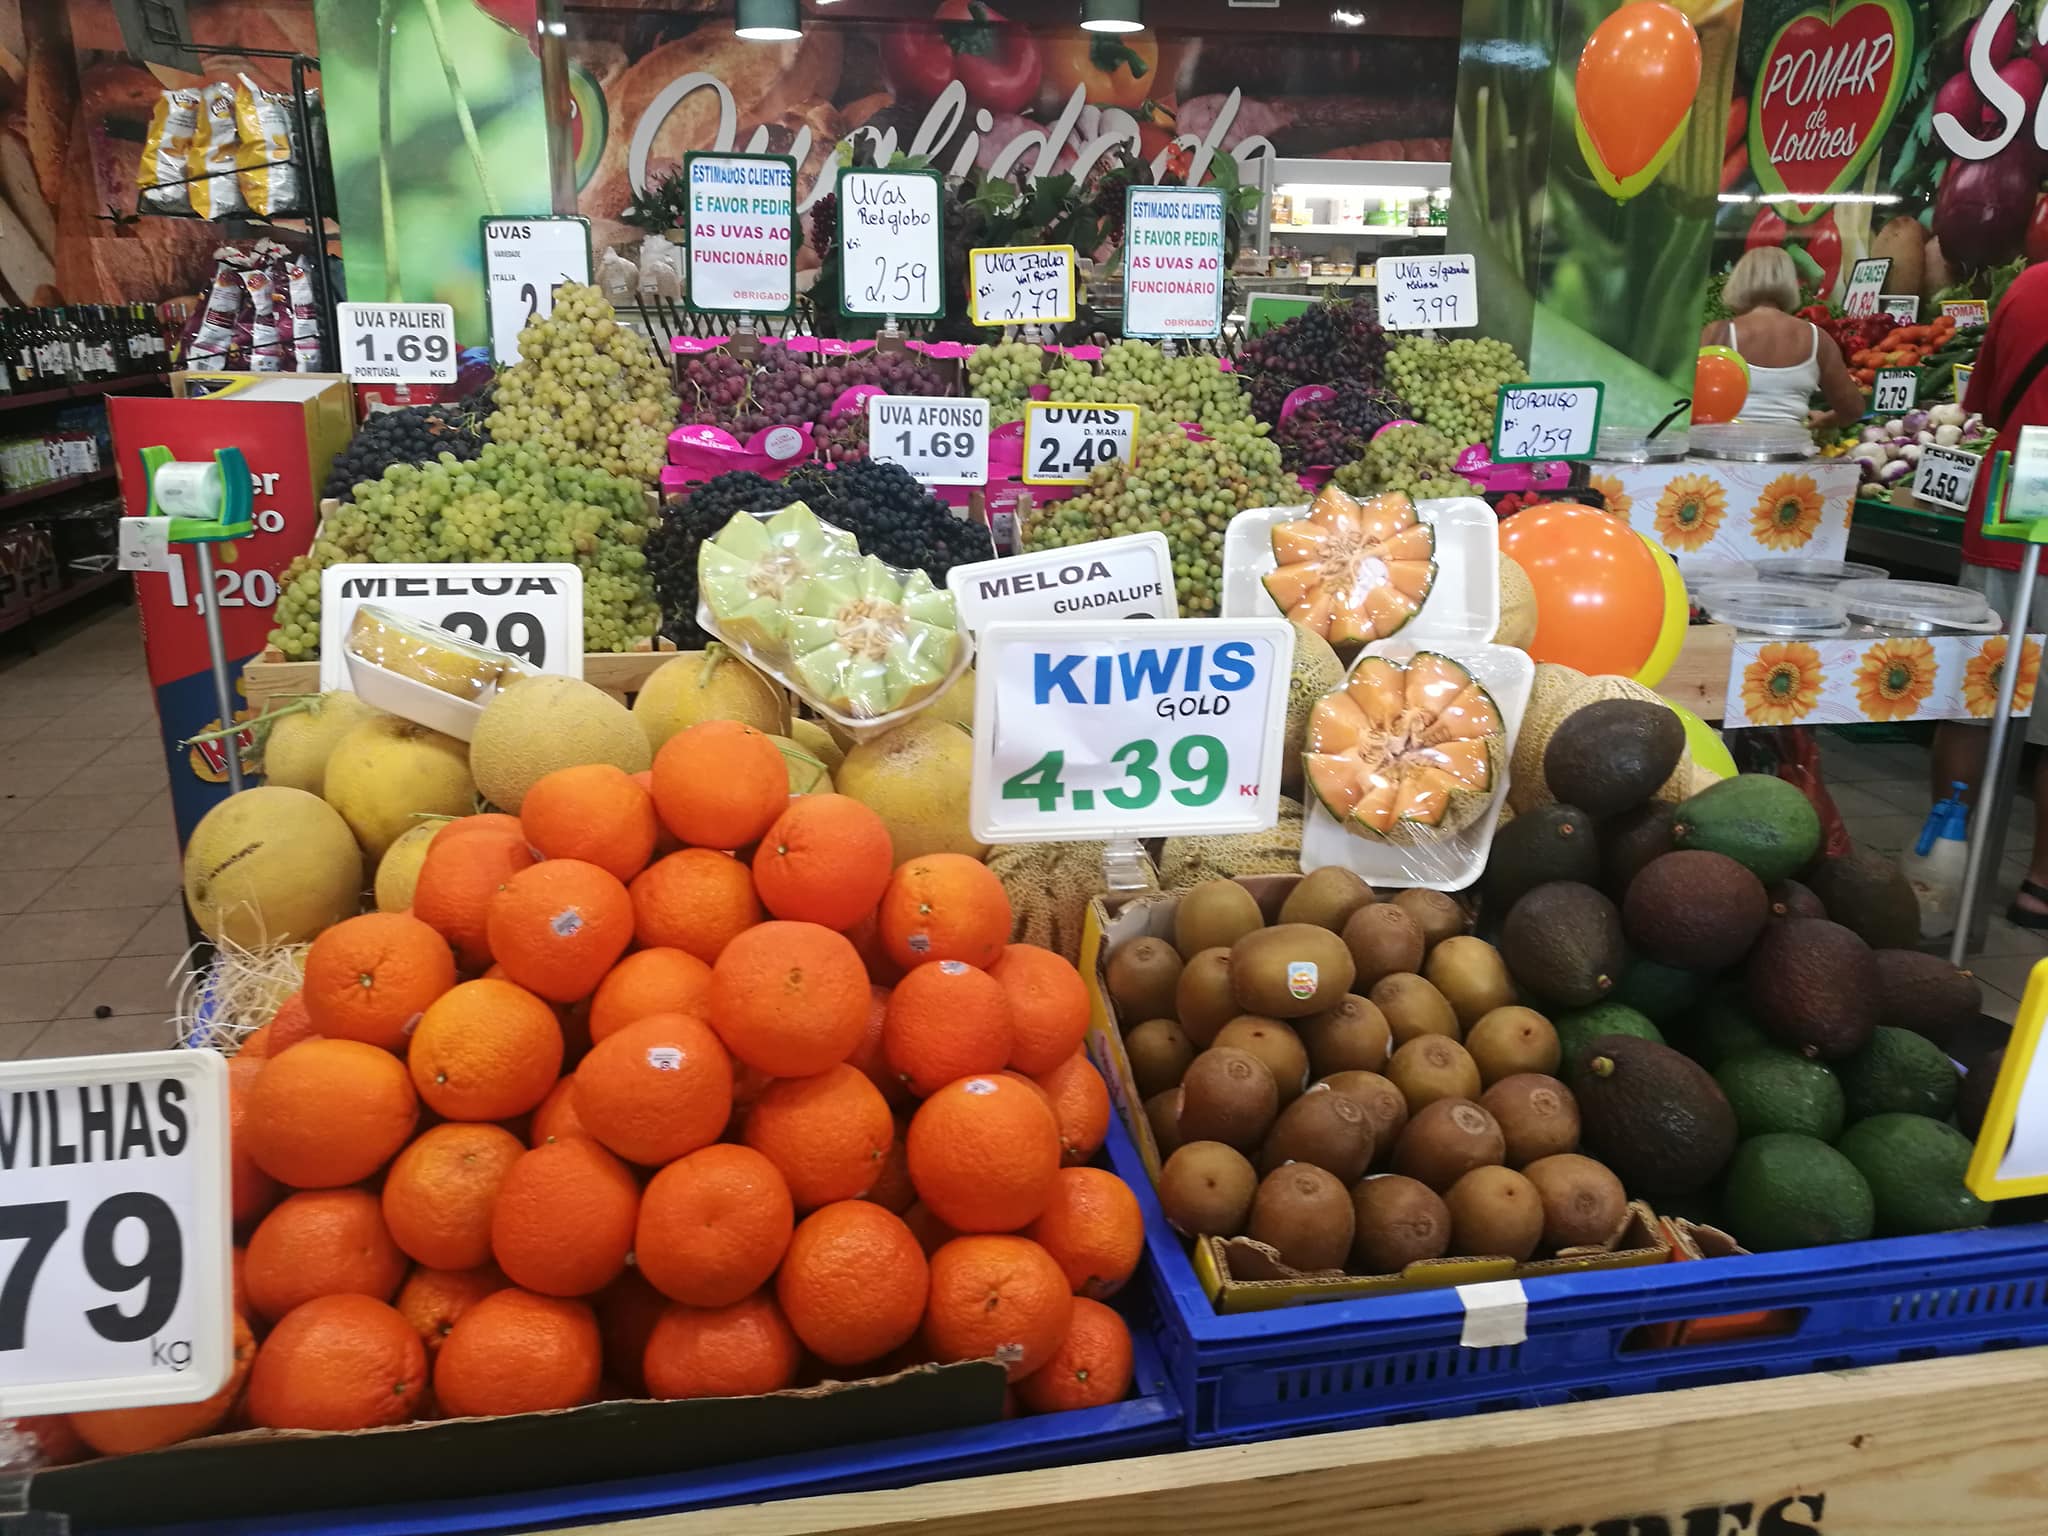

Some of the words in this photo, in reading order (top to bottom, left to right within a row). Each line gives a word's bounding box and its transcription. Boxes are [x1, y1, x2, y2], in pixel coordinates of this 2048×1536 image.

[1763, 33, 1894, 110] POMAR
[1805, 102, 1827, 129] de
[1770, 120, 1858, 164] Loures
[693, 165, 745, 184] ESTIMADOS
[748, 168, 791, 186] CLIENTES
[850, 176, 906, 206] Uvas
[695, 192, 703, 211] É
[707, 196, 748, 214] FAVOR
[753, 198, 791, 216] PEDIR
[1133, 202, 1179, 219] ESTIMADOS
[1182, 204, 1222, 220] CLIENTES
[488, 226, 532, 240] UVAS
[695, 223, 715, 237] AS
[721, 225, 764, 239] UVAS
[769, 227, 791, 241] AO
[1134, 226, 1141, 245] É
[1145, 230, 1181, 246] FAVOR
[1185, 231, 1219, 247] PEDIR
[694, 249, 788, 267] FUNCIONÁRIO
[1133, 256, 1151, 269] AS
[1156, 256, 1193, 270] UVAS
[1198, 257, 1218, 270] AO
[492, 273, 517, 281] ITALIA
[1131, 279, 1215, 295] FUNCIONÁRIO
[733, 291, 789, 301] OBRIGADO
[355, 311, 385, 328] UVA
[390, 312, 445, 329] PALIERI
[1164, 319, 1215, 327] OBRIGADO
[355, 334, 449, 362] 1.69
[355, 367, 400, 377] PORTUGAL
[430, 370, 447, 378] KG
[1877, 386, 1908, 410] 2.79
[880, 406, 913, 425] UVA
[918, 407, 983, 427] AFONSO
[1045, 408, 1120, 425] UVAS
[896, 430, 975, 458] 1.69
[1084, 429, 1093, 437] D.
[1096, 429, 1127, 437] MARIA
[1038, 437, 1118, 473] 2.49
[1921, 468, 1959, 502] 2.59
[979, 562, 1112, 600] MELOA
[1054, 582, 1163, 614] GUADALUPE
[1034, 641, 1256, 705] KIWIS
[1156, 695, 1230, 721] GOLD
[1002, 734, 1229, 812] 4.39
[151, 1336, 193, 1371] kg
